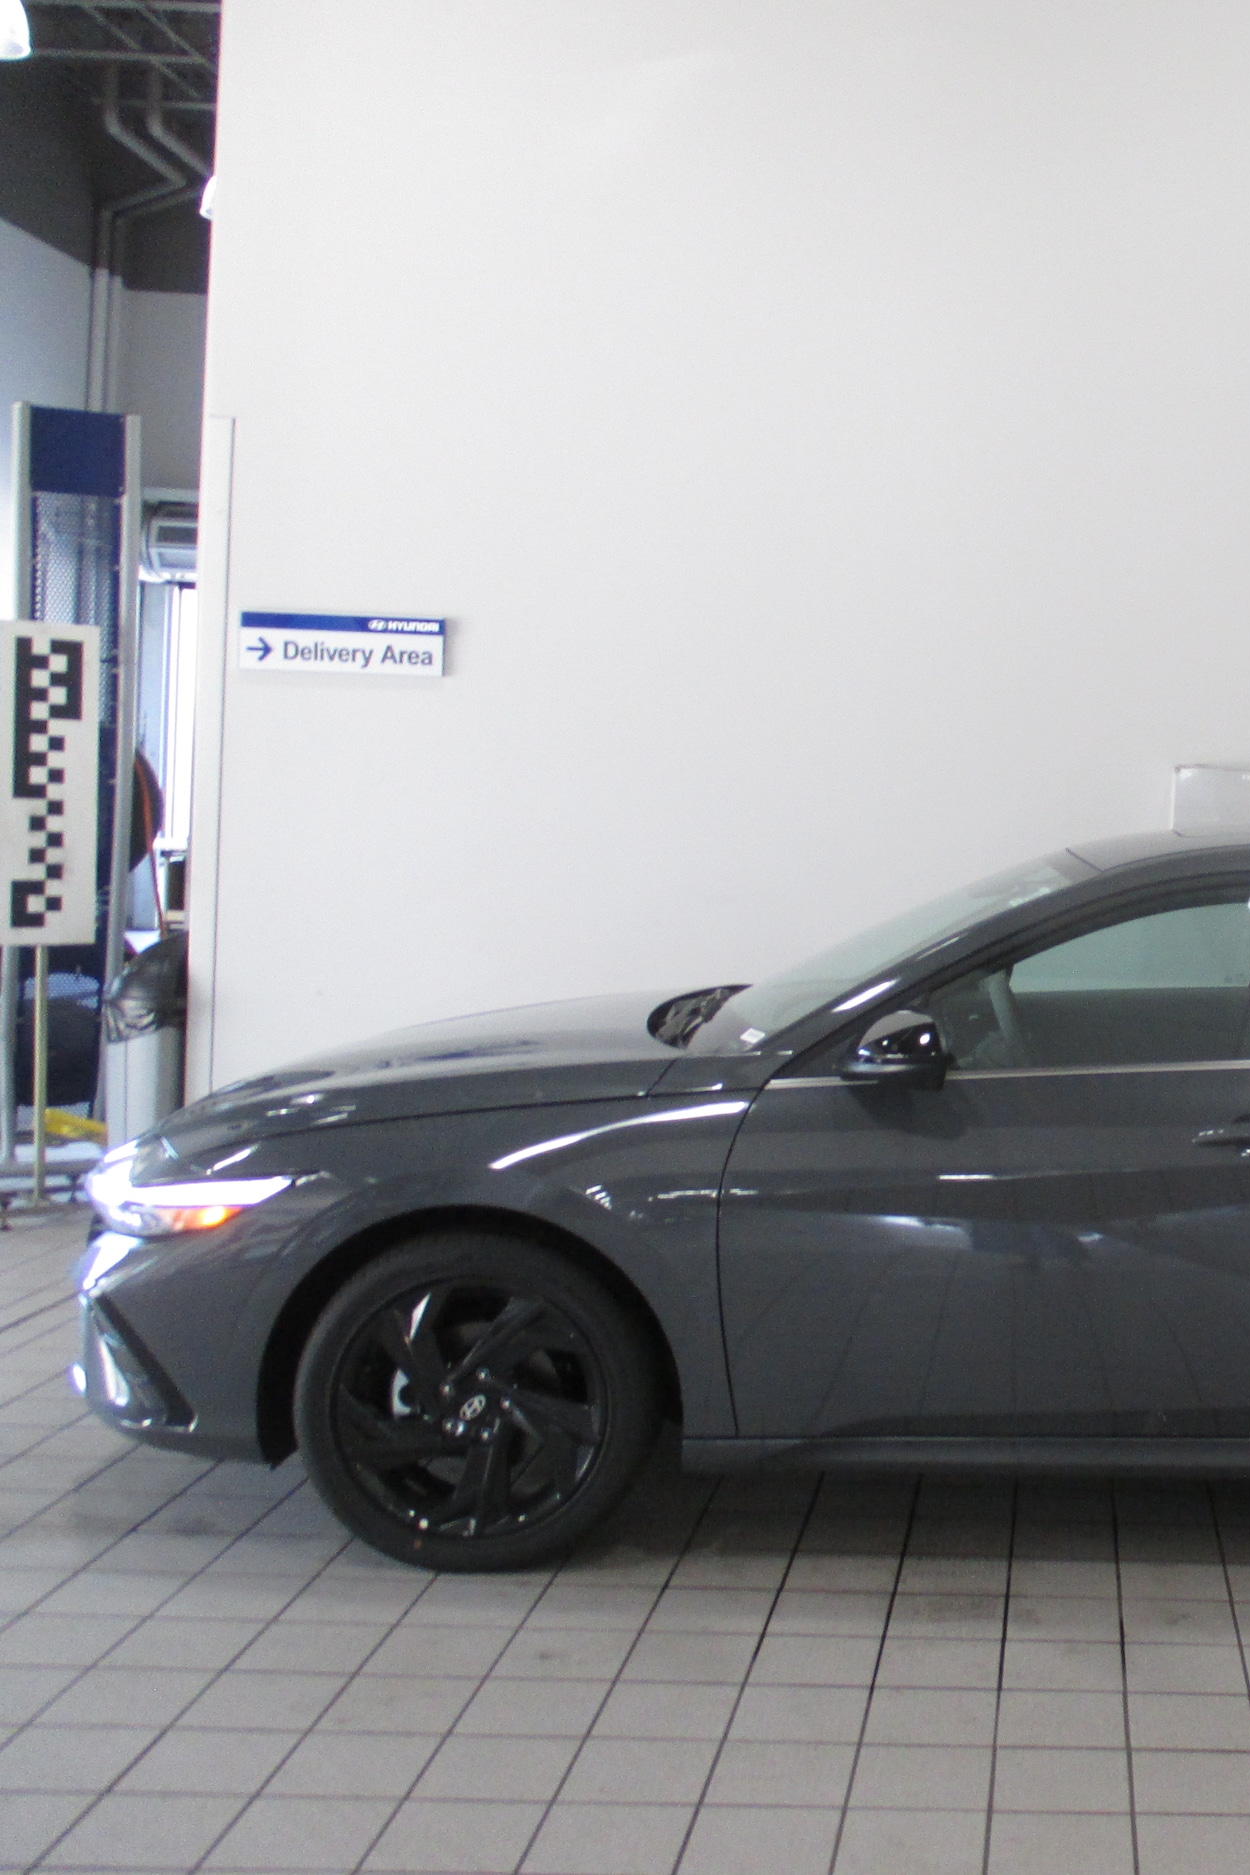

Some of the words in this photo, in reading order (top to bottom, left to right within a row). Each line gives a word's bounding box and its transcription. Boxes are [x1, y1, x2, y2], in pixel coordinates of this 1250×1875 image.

[387, 620, 440, 633] HYUNDAI
[283, 640, 374, 669] Delivery
[381, 644, 433, 666] Area
